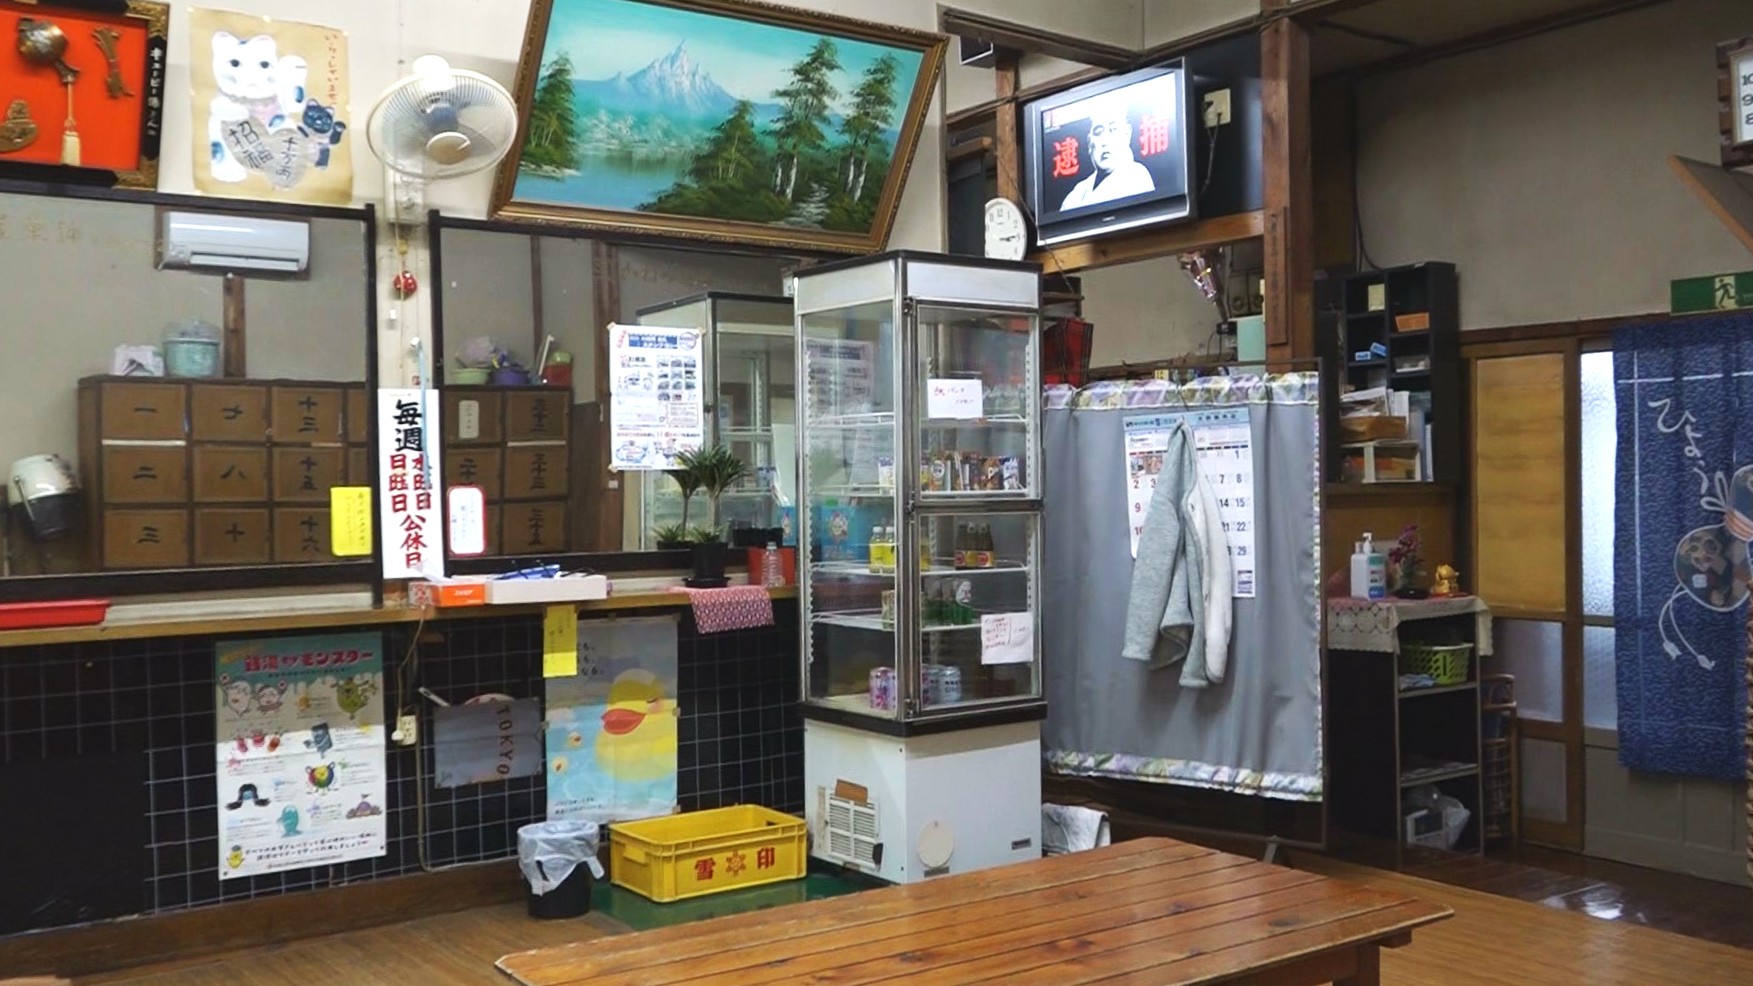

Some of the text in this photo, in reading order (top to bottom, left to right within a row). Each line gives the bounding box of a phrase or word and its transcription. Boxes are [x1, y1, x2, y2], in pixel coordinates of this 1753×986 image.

[229, 121, 274, 168] 招福
[1053, 115, 1169, 177] 逮 捕
[393, 399, 424, 452] 毎週
[1235, 450, 1239, 459] 1
[1133, 479, 1140, 489] 2
[1219, 474, 1225, 484] 7
[1134, 498, 1245, 513] 9 14 15
[400, 514, 428, 569] 公休日
[1236, 522, 1246, 532] 22
[1237, 546, 1247, 556] 29
[496, 705, 514, 775] TOKYO
[694, 847, 775, 881] 雪 印
